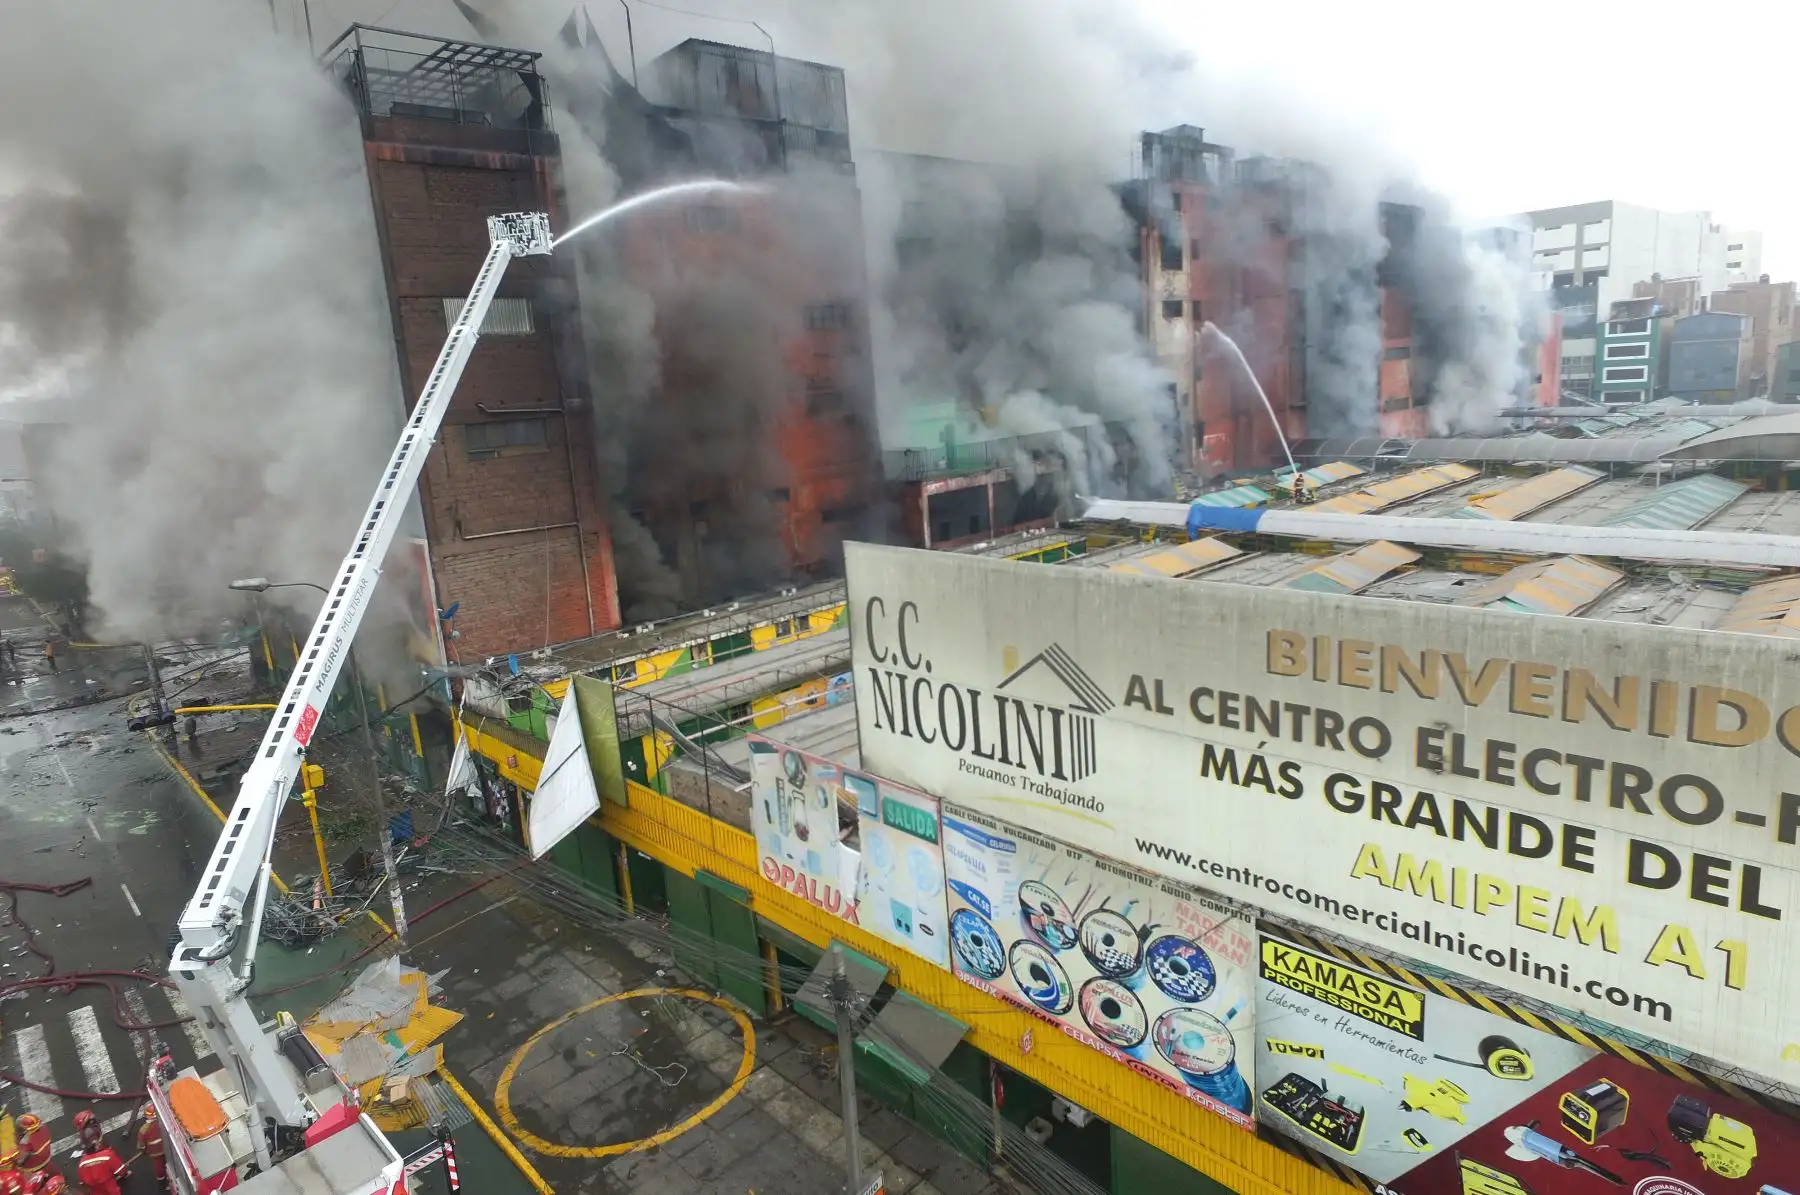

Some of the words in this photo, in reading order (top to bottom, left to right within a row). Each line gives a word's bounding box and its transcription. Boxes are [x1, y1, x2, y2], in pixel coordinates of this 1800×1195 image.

[341, 577, 369, 632] MULTISTAR
[866, 596, 932, 673] C.C.
[316, 637, 343, 693] MAGIRUS
[869, 667, 1068, 781] NICOLINI
[1123, 674, 1174, 716] AL
[1189, 686, 1392, 759] CENTRO
[958, 758, 1016, 787] Peruanos
[1020, 775, 1104, 813] Trabajando
[886, 802, 936, 840] SALIDA
[1200, 741, 1304, 800] MÁS
[1323, 772, 1597, 874] GRANDE
[1627, 838, 1781, 921] DEL
[762, 856, 860, 925] OPALUX
[945, 805, 965, 818] CABLE
[967, 813, 997, 830] COAXIAL
[1003, 826, 1056, 851] VULCANIZADO
[1066, 849, 1083, 861] UTP
[1095, 860, 1153, 887] AUTOMOTRIZ
[1161, 884, 1191, 902] AUDIO
[1200, 898, 1251, 923] COMPUTO
[1135, 837, 1672, 1022] www.centrocomercialnicolini.com
[1175, 901, 1226, 938] MADE
[1230, 932, 1252, 954] IN
[1351, 842, 1621, 954] AMIPEM
[1644, 923, 1748, 991] A1
[1264, 968, 1418, 1037] PROFESSIONAL
[1273, 946, 1407, 1016] KAMASA
[1314, 1013, 1329, 1025] en
[1334, 1015, 1428, 1065] Herramientas
[1063, 1026, 1122, 1062] CELAPSA
[1186, 1086, 1249, 1128] Konstar
